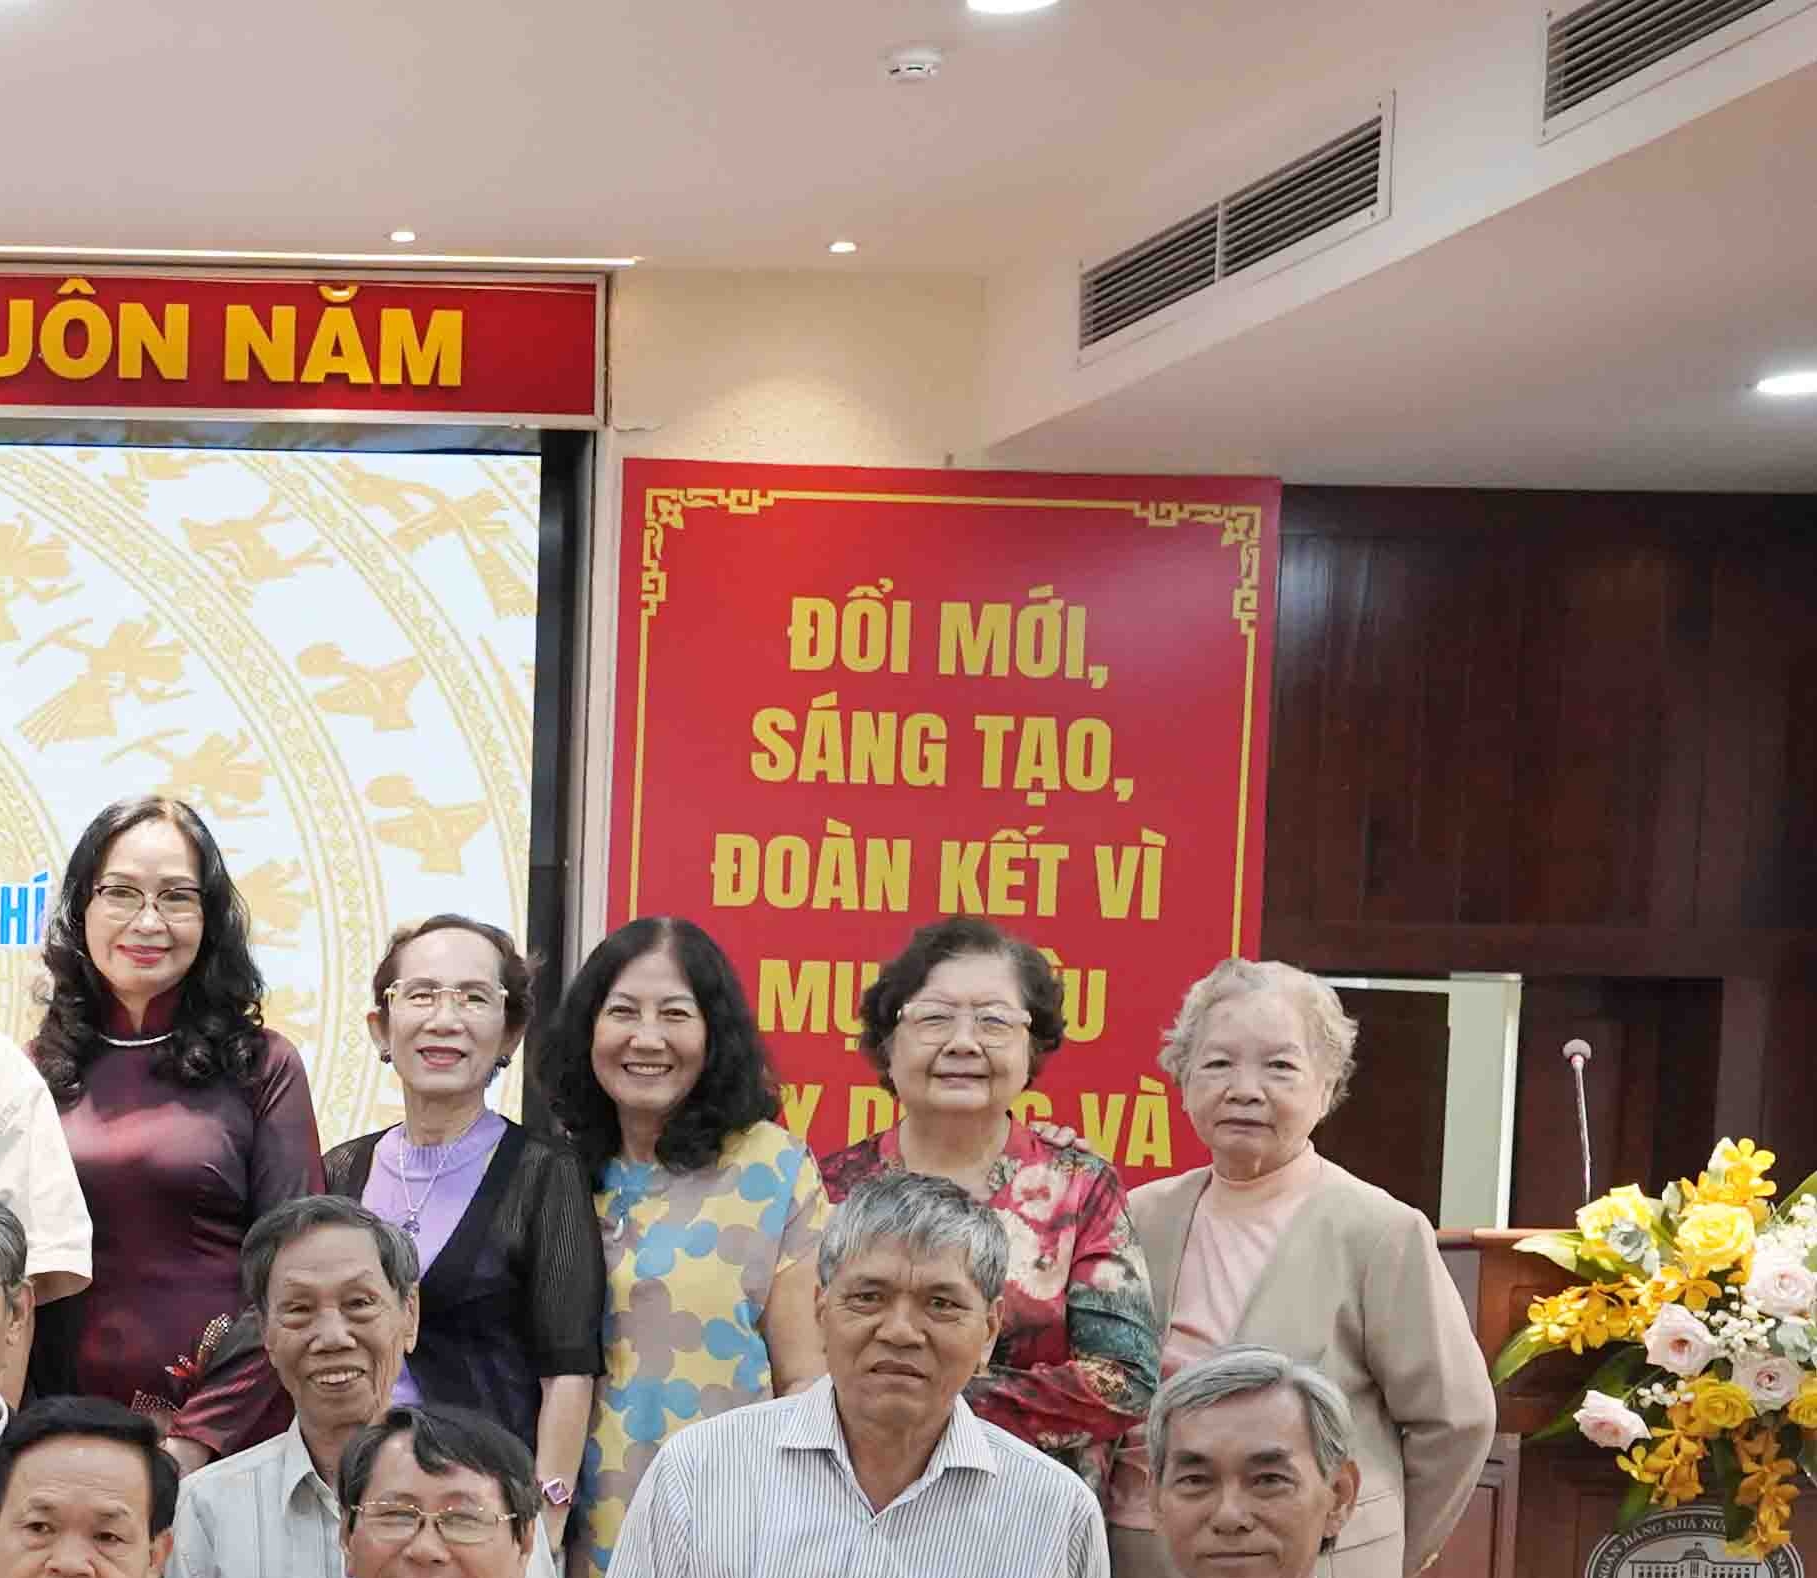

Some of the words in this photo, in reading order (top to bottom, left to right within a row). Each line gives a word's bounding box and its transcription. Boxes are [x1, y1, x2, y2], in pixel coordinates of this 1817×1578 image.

[227, 284, 464, 387] NĂM
[787, 578, 910, 673] ĐỔI
[938, 585, 1109, 689] MỚI,
[751, 692, 947, 787] SÁNG
[975, 715, 1135, 807] TẠO,
[711, 818, 911, 914] ĐOÀN
[938, 825, 1069, 917] KẾT
[1095, 827, 1167, 920] VÌ
[1080, 1076, 1172, 1168] VÀ
